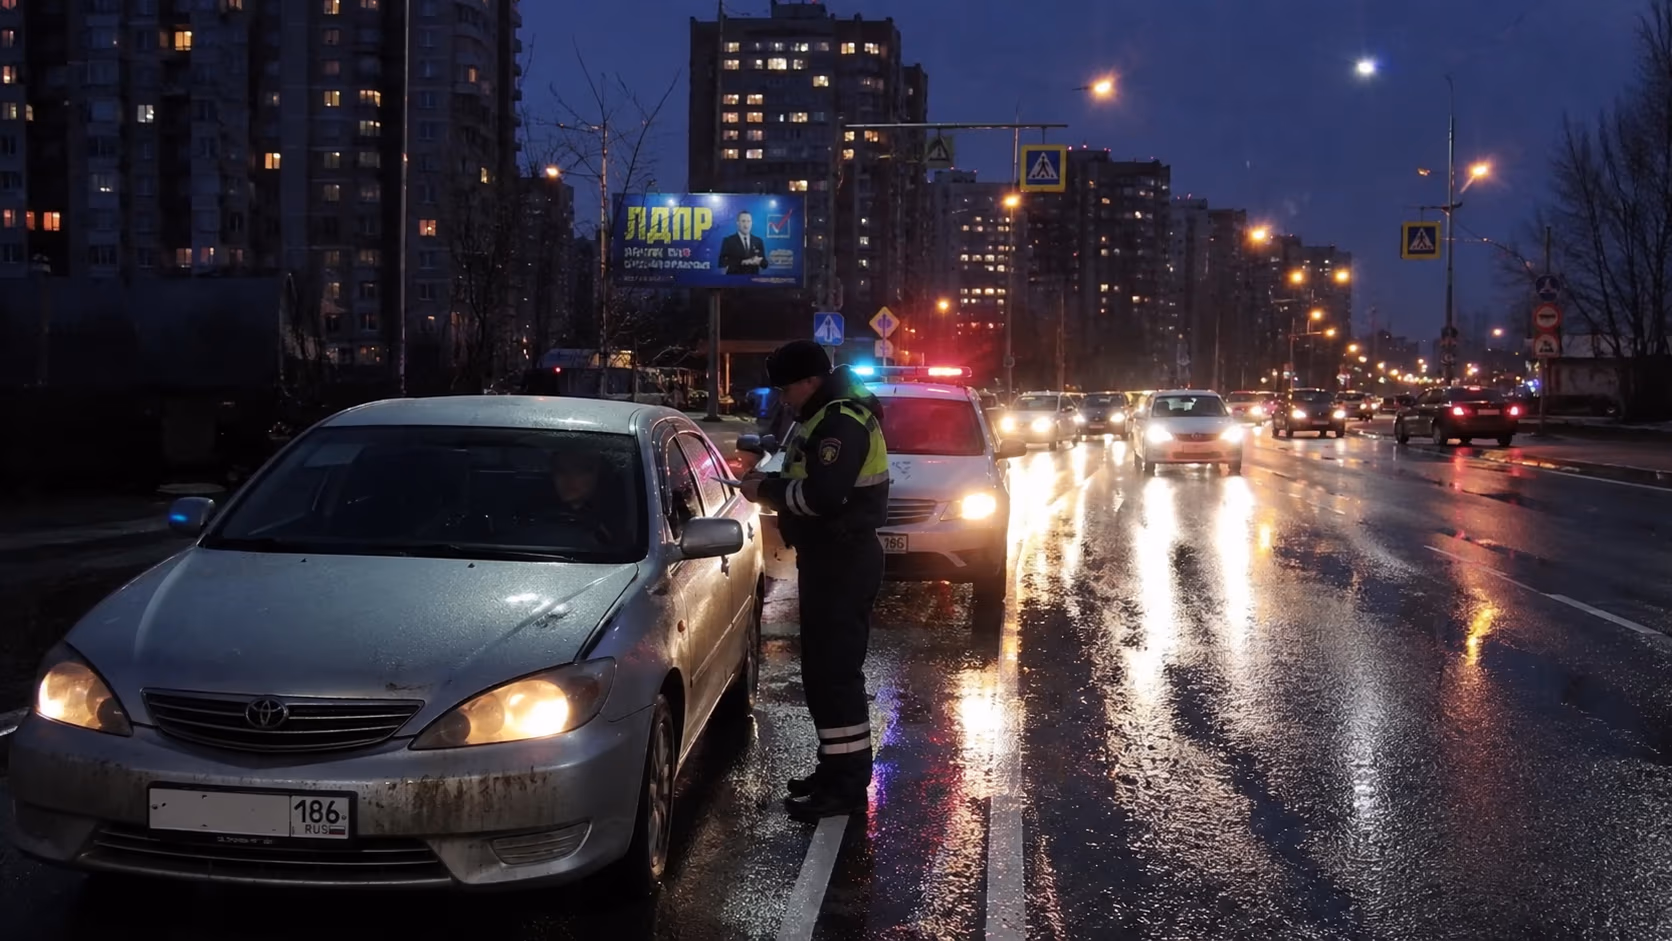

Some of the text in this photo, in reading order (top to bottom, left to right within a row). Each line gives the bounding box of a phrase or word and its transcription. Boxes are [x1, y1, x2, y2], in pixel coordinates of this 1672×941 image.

[624, 206, 713, 244] ЛДПР
[294, 800, 340, 824] 186
[305, 824, 328, 835] RUS
